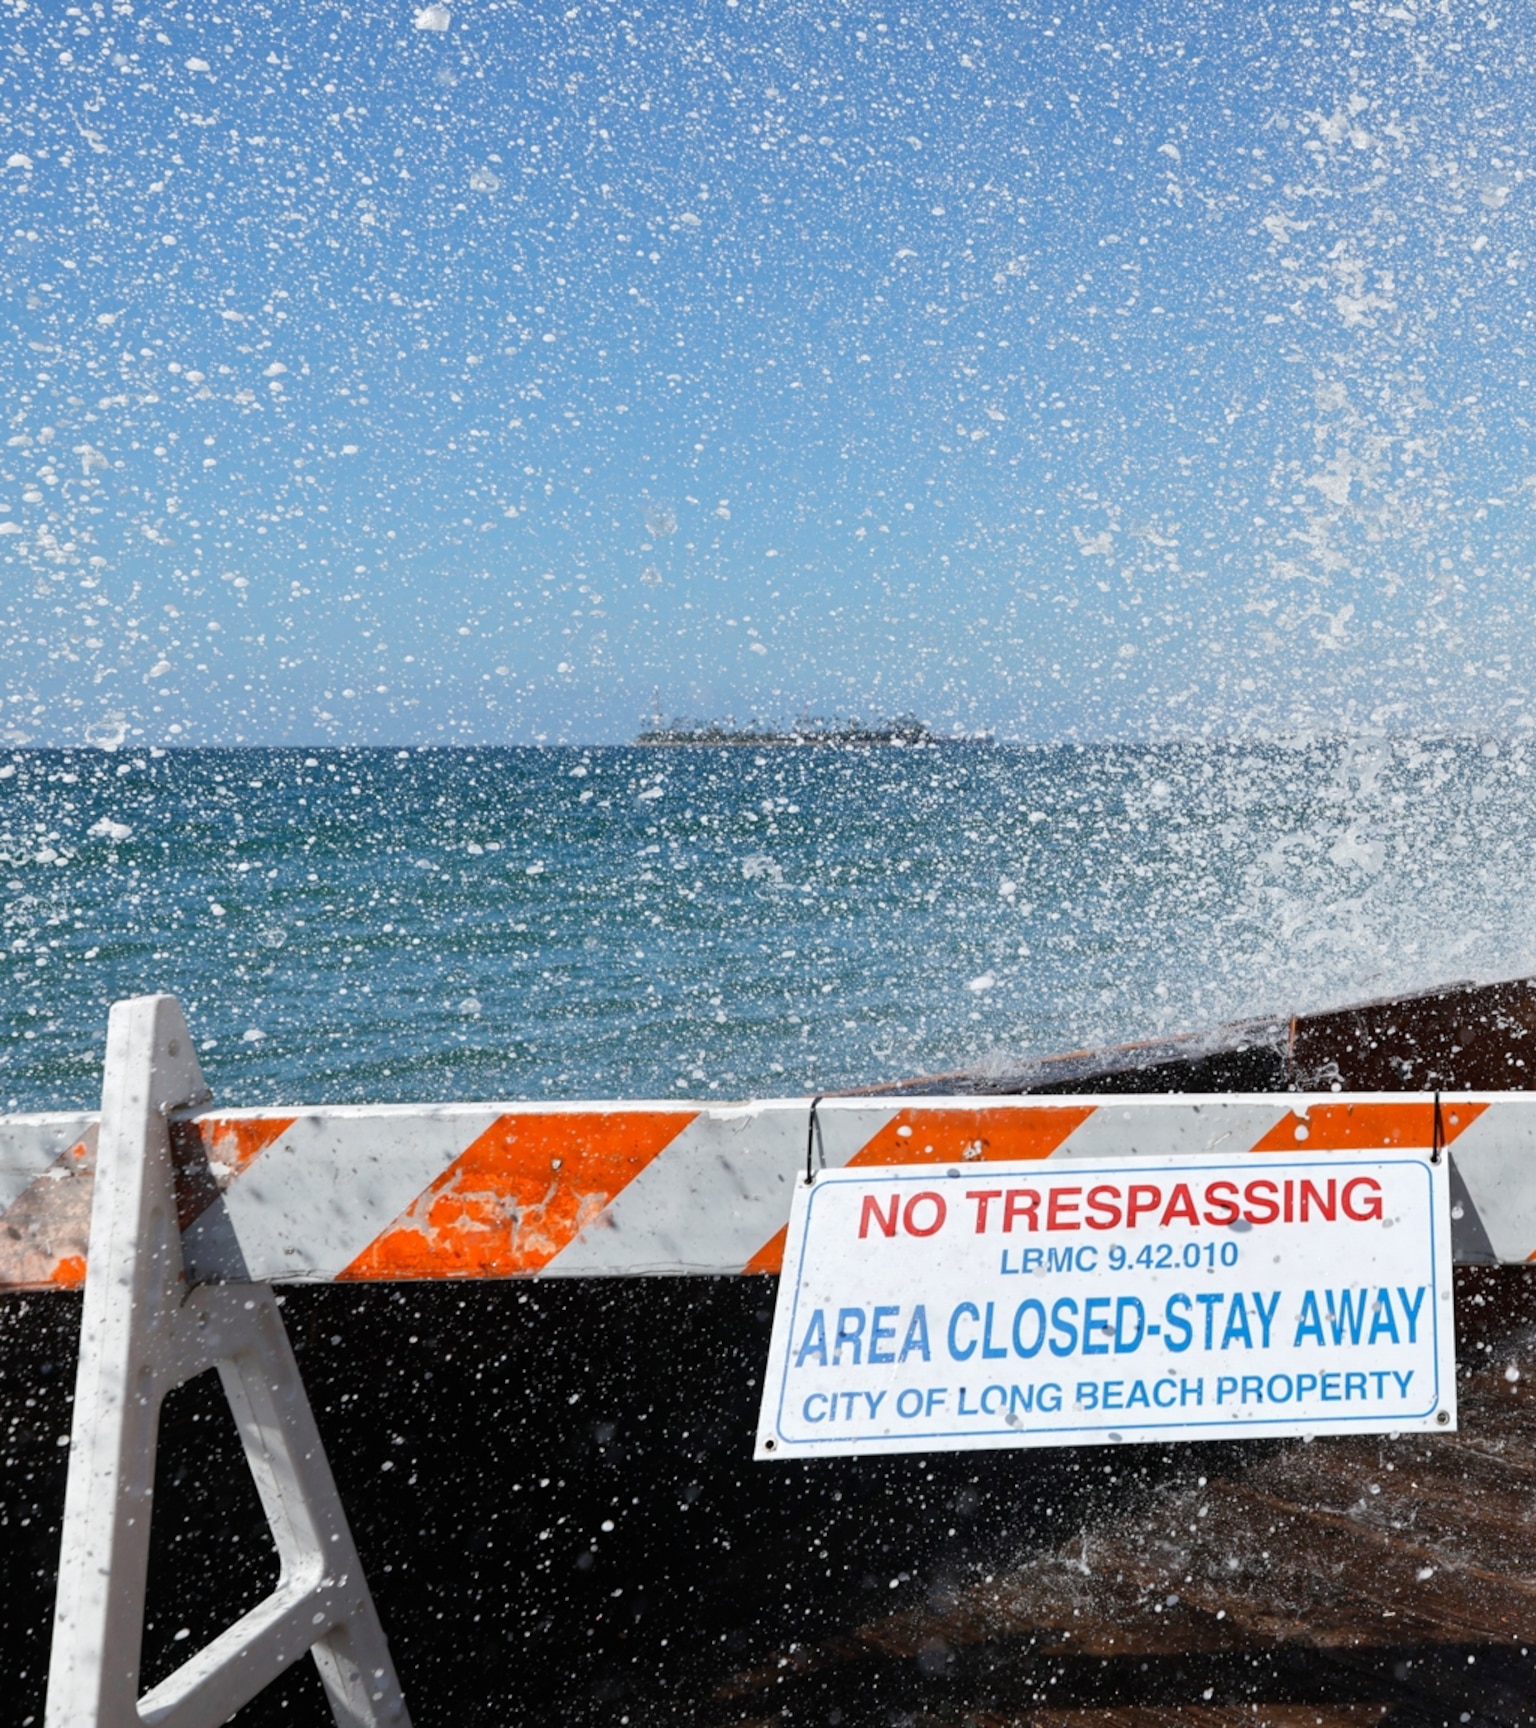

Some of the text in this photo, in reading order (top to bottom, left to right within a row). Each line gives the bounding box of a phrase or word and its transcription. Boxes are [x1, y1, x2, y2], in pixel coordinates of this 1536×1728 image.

[858, 1176, 1383, 1239] NO TRESPASSING
[1000, 1241, 1239, 1275] LBMC 9.42.010
[795, 1285, 1426, 1367] AREA CLOSED-STAY AWAY
[803, 1371, 1415, 1423] CITY OF LONG BEACH PROPERTY
